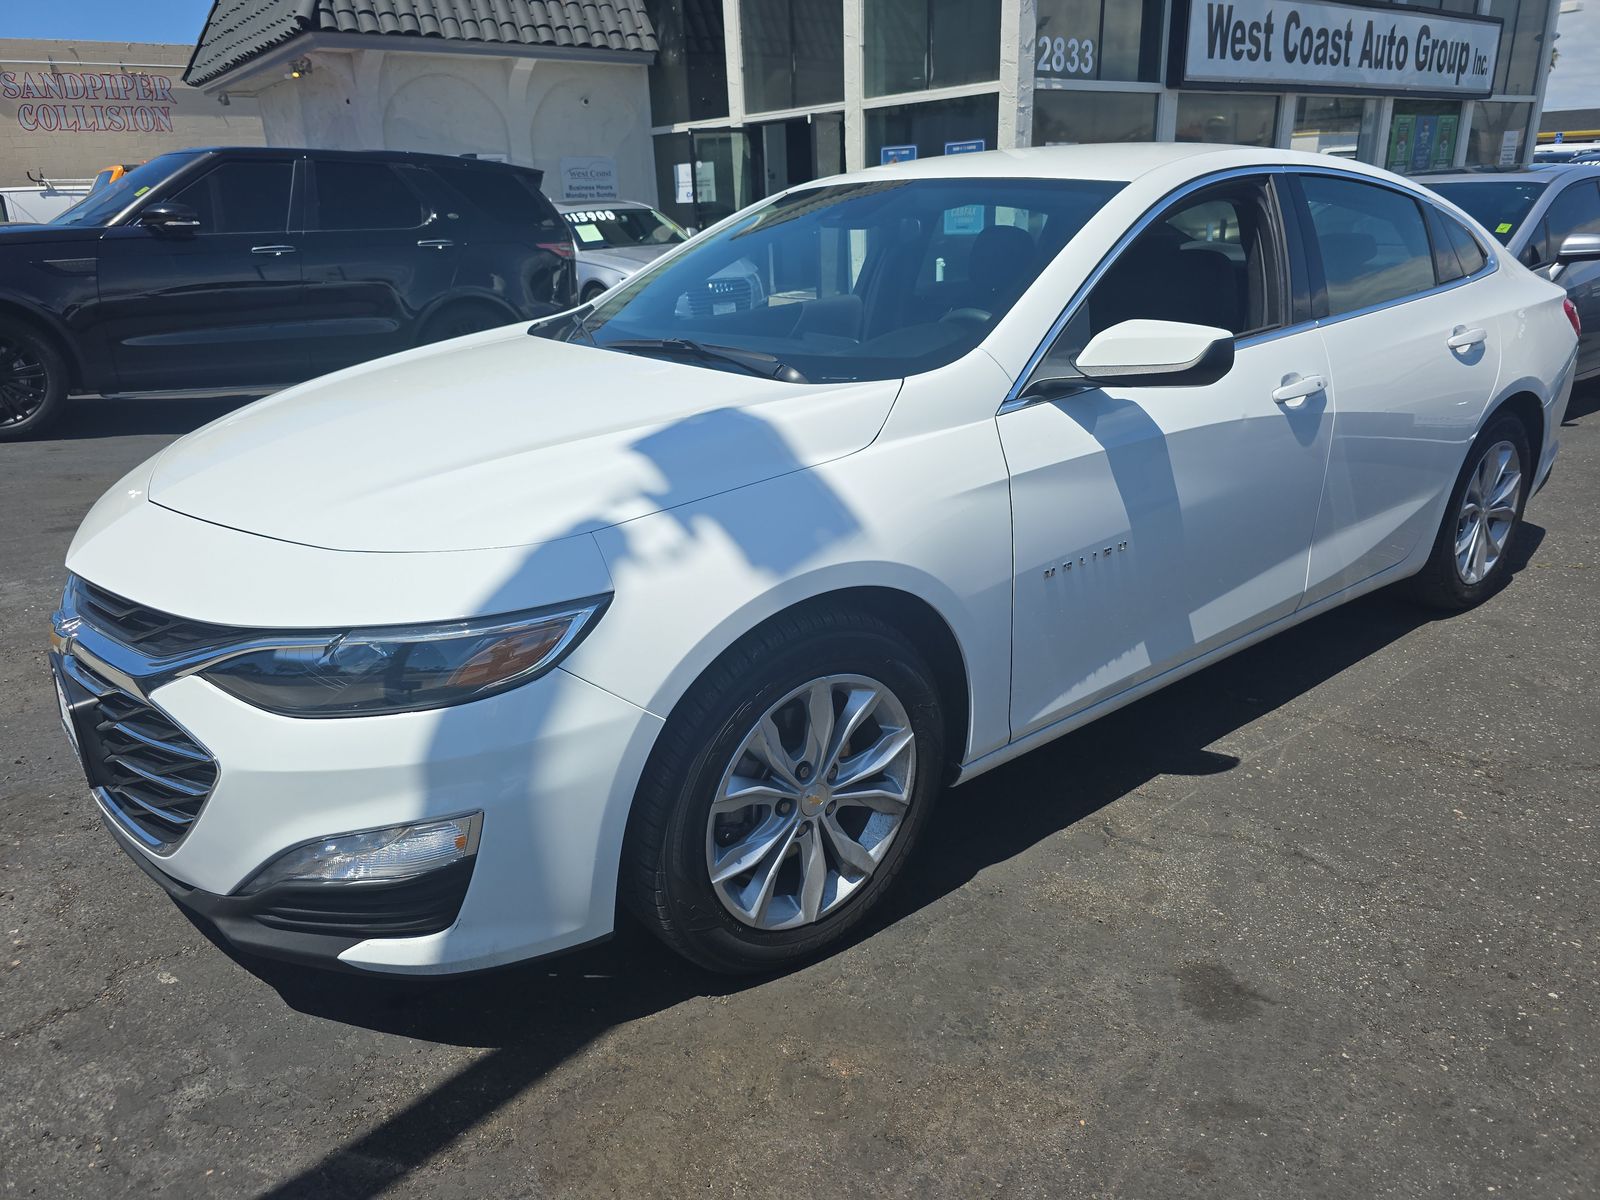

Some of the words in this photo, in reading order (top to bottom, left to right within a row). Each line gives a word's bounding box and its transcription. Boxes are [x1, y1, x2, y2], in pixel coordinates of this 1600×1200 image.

[1037, 35, 1093, 74] 2833
[1207, 3, 1274, 62] West
[1283, 10, 1353, 67] Coast
[1358, 20, 1409, 71] Auto
[1415, 24, 1469, 86] Group
[1472, 47, 1488, 77] Inc.
[0, 71, 178, 104] SANDPIPER
[18, 104, 174, 133] COLLISION
